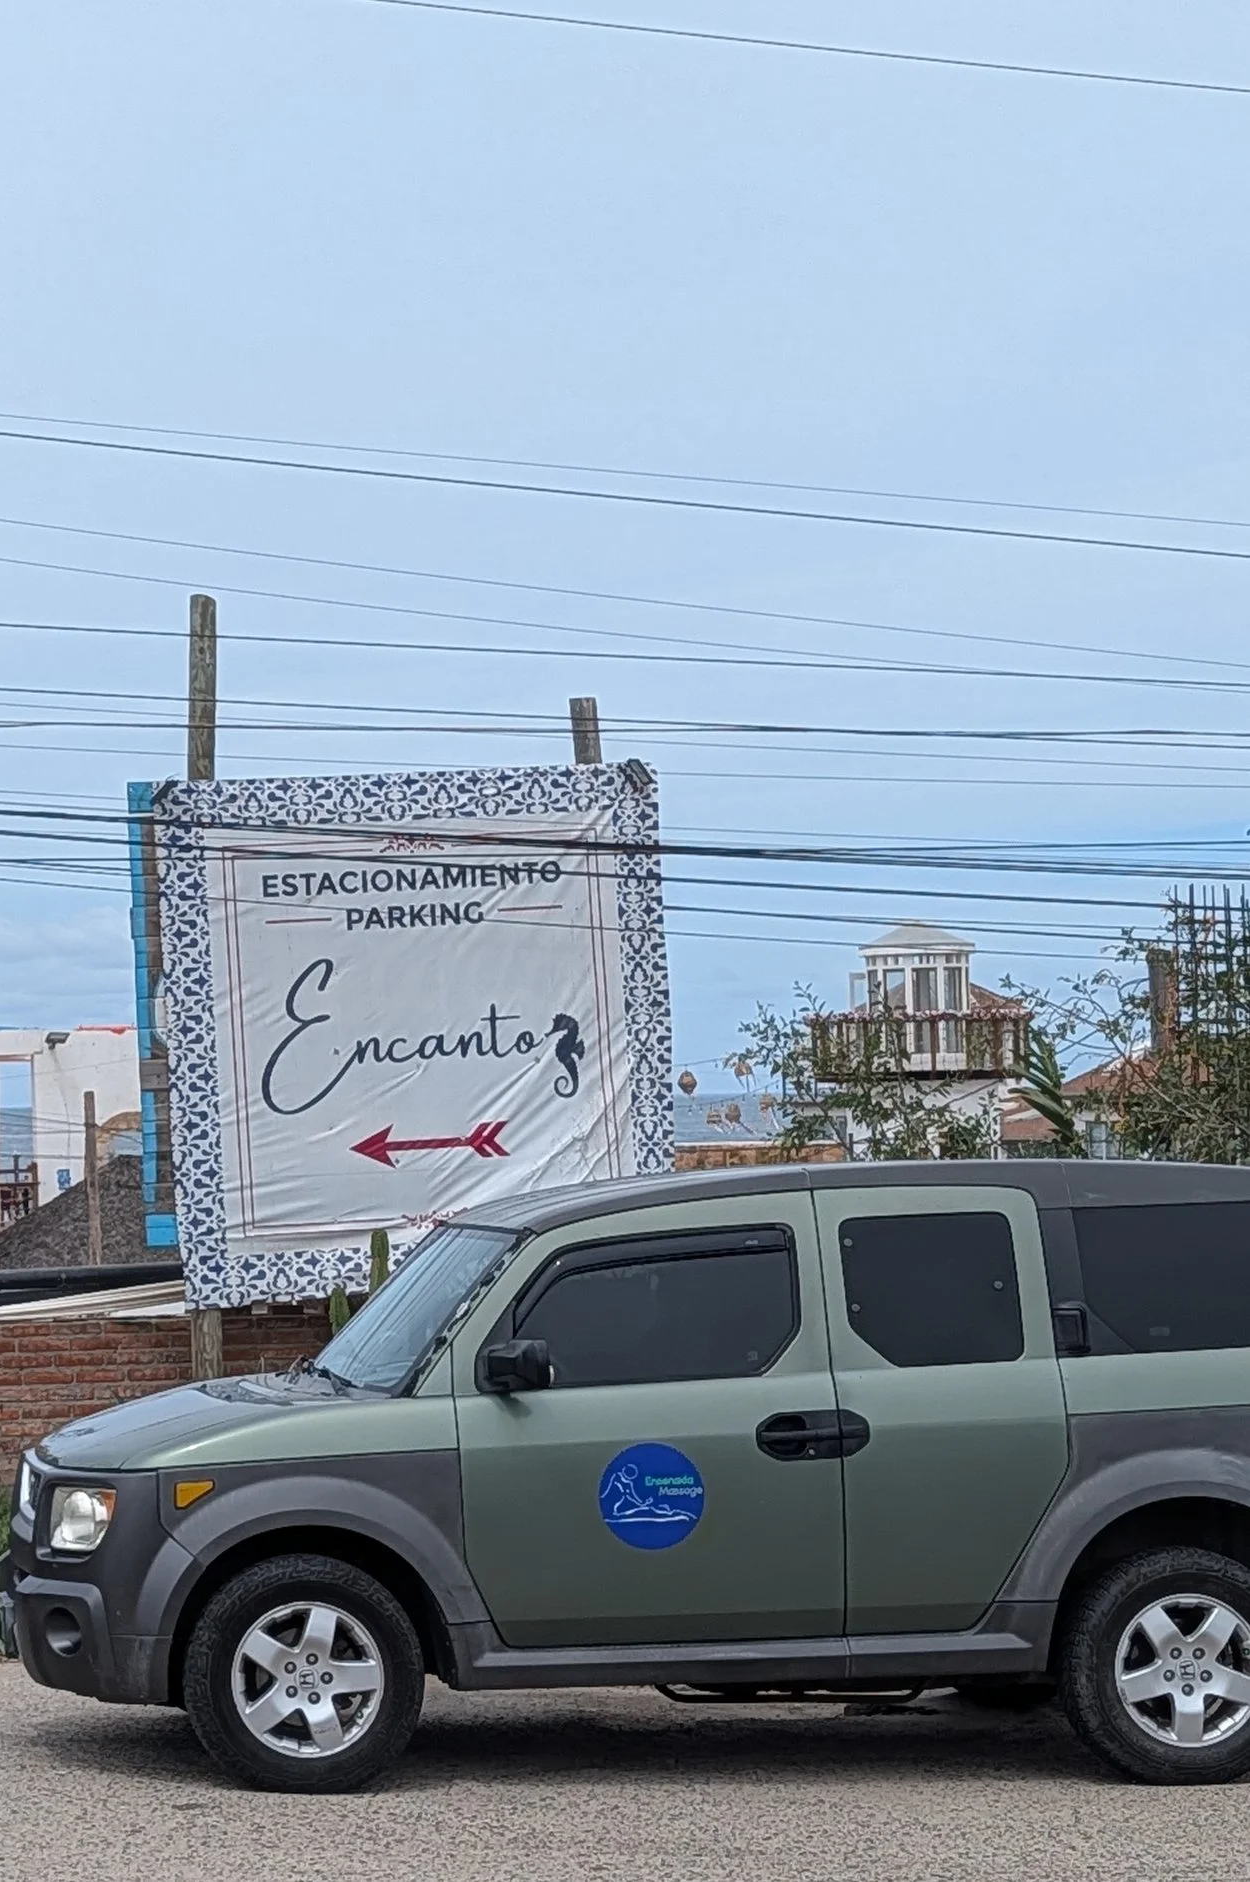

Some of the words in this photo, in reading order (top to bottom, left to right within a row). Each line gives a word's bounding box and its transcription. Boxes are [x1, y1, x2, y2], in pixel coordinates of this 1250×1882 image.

[262, 860, 561, 897] ESTACIONAMIENTO
[346, 901, 484, 931] PARKING
[261, 958, 547, 1114] Encanto
